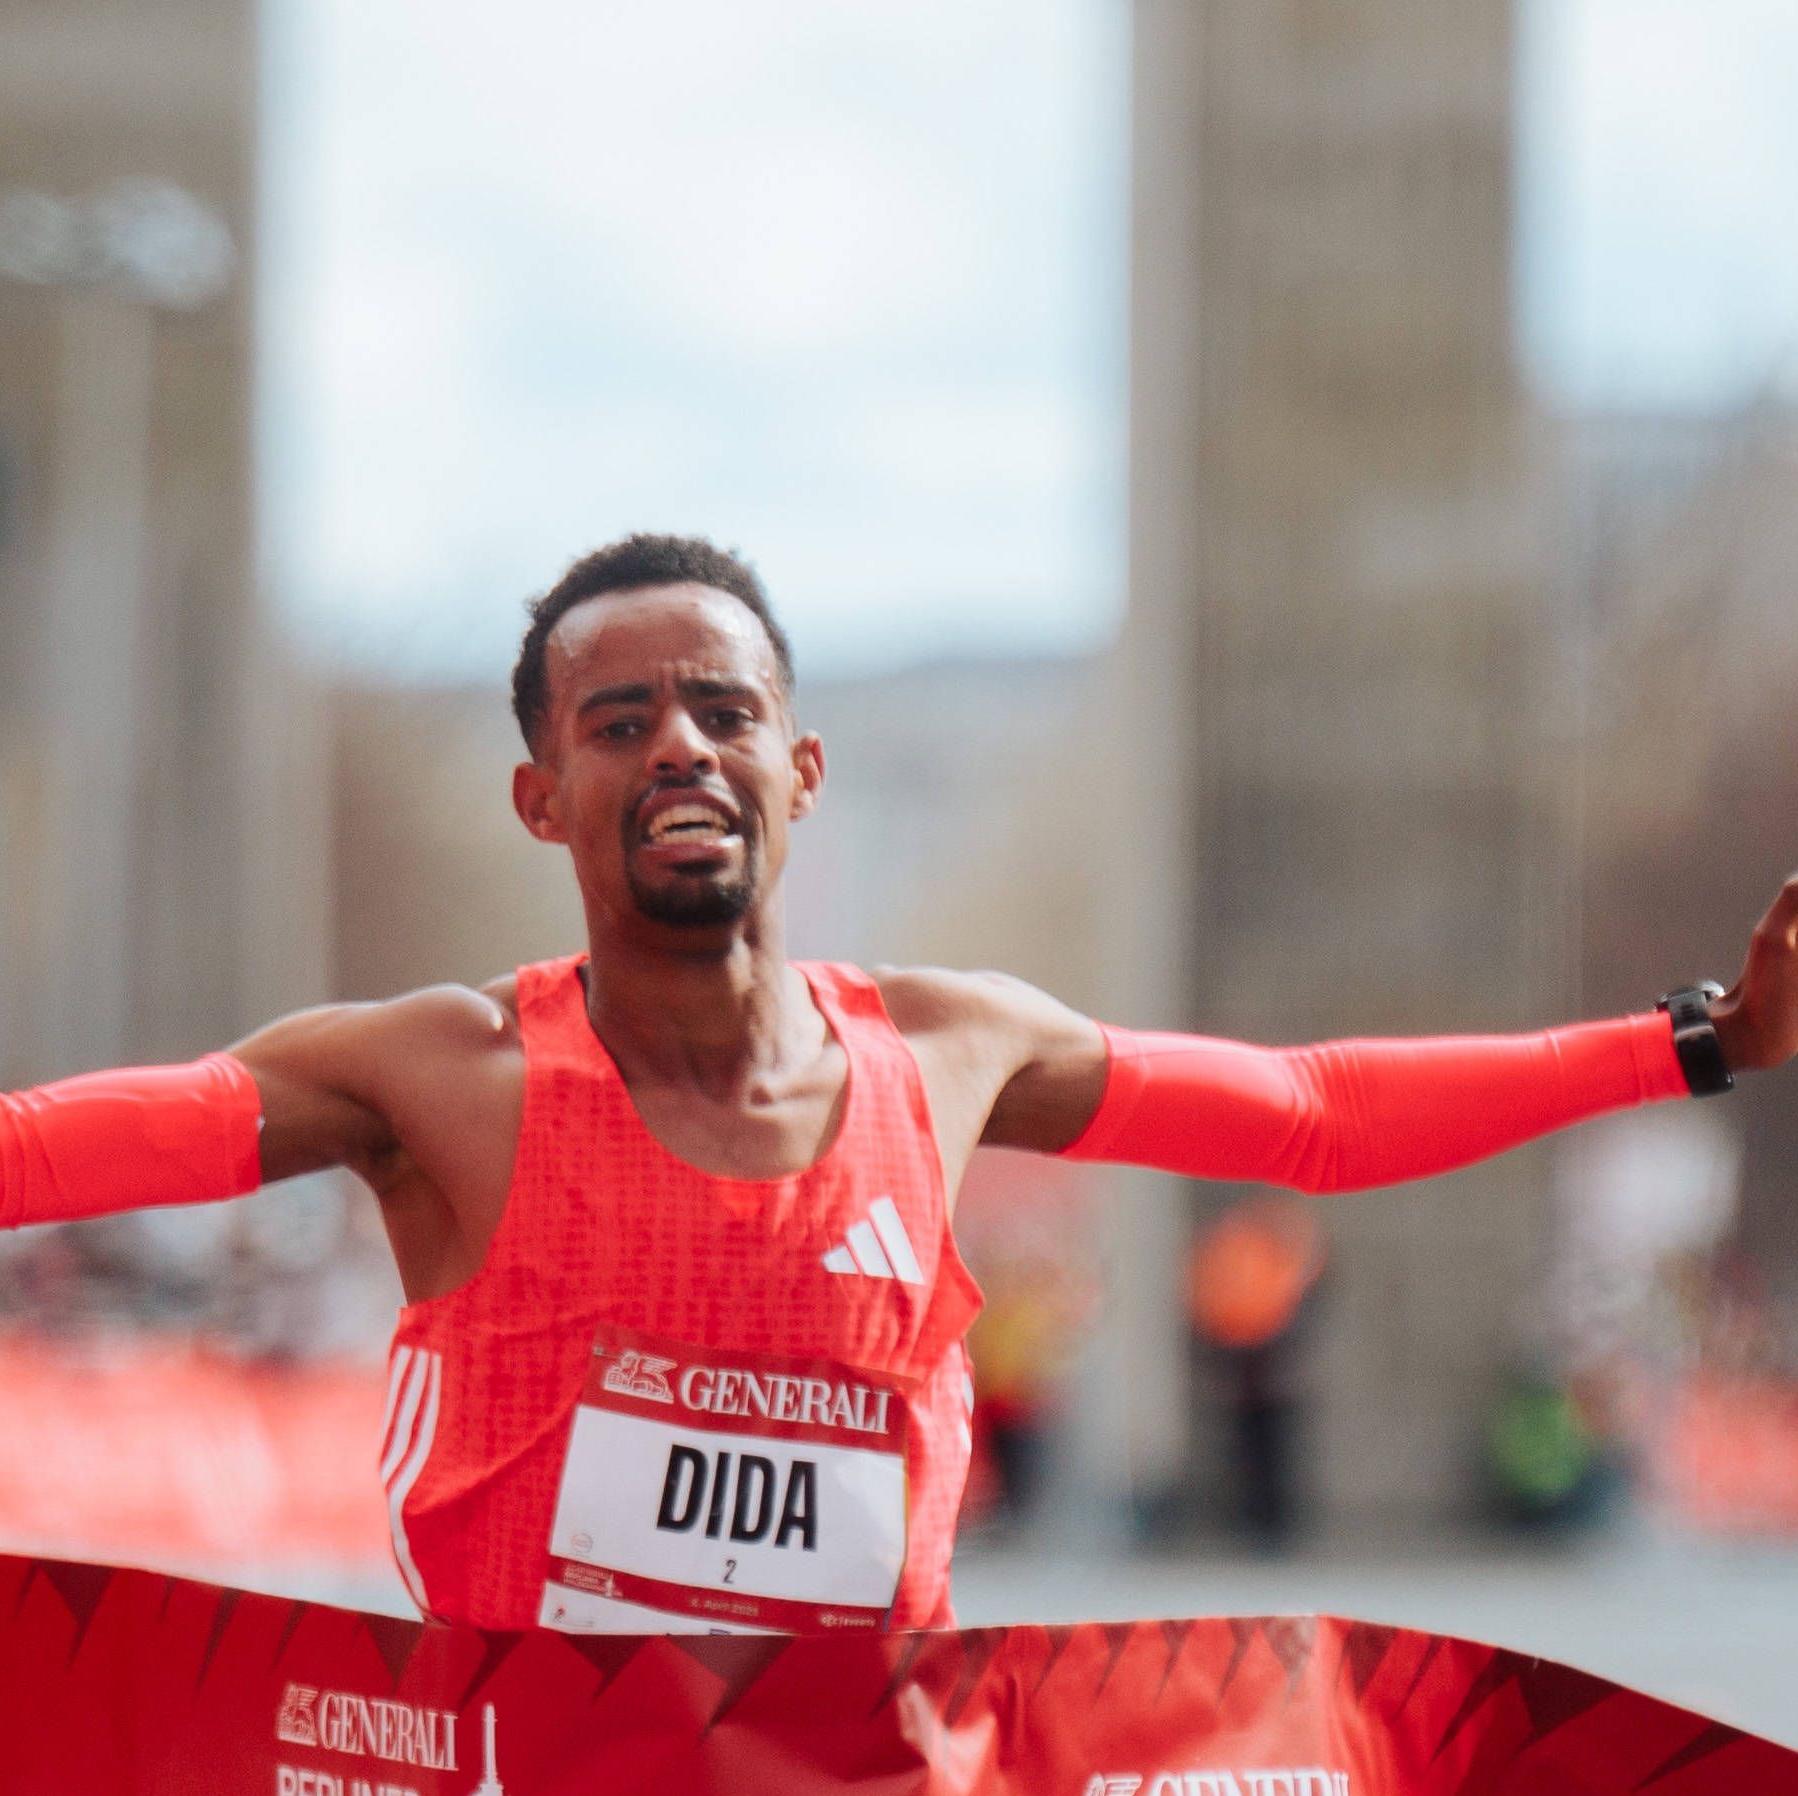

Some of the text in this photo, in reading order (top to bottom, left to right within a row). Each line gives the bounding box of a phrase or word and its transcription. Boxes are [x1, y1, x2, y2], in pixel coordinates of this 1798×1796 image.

[680, 1366, 893, 1435] GENERALI
[657, 1444, 818, 1552] DIDA
[721, 1559, 738, 1585] 2
[318, 1690, 460, 1772] GENERALI
